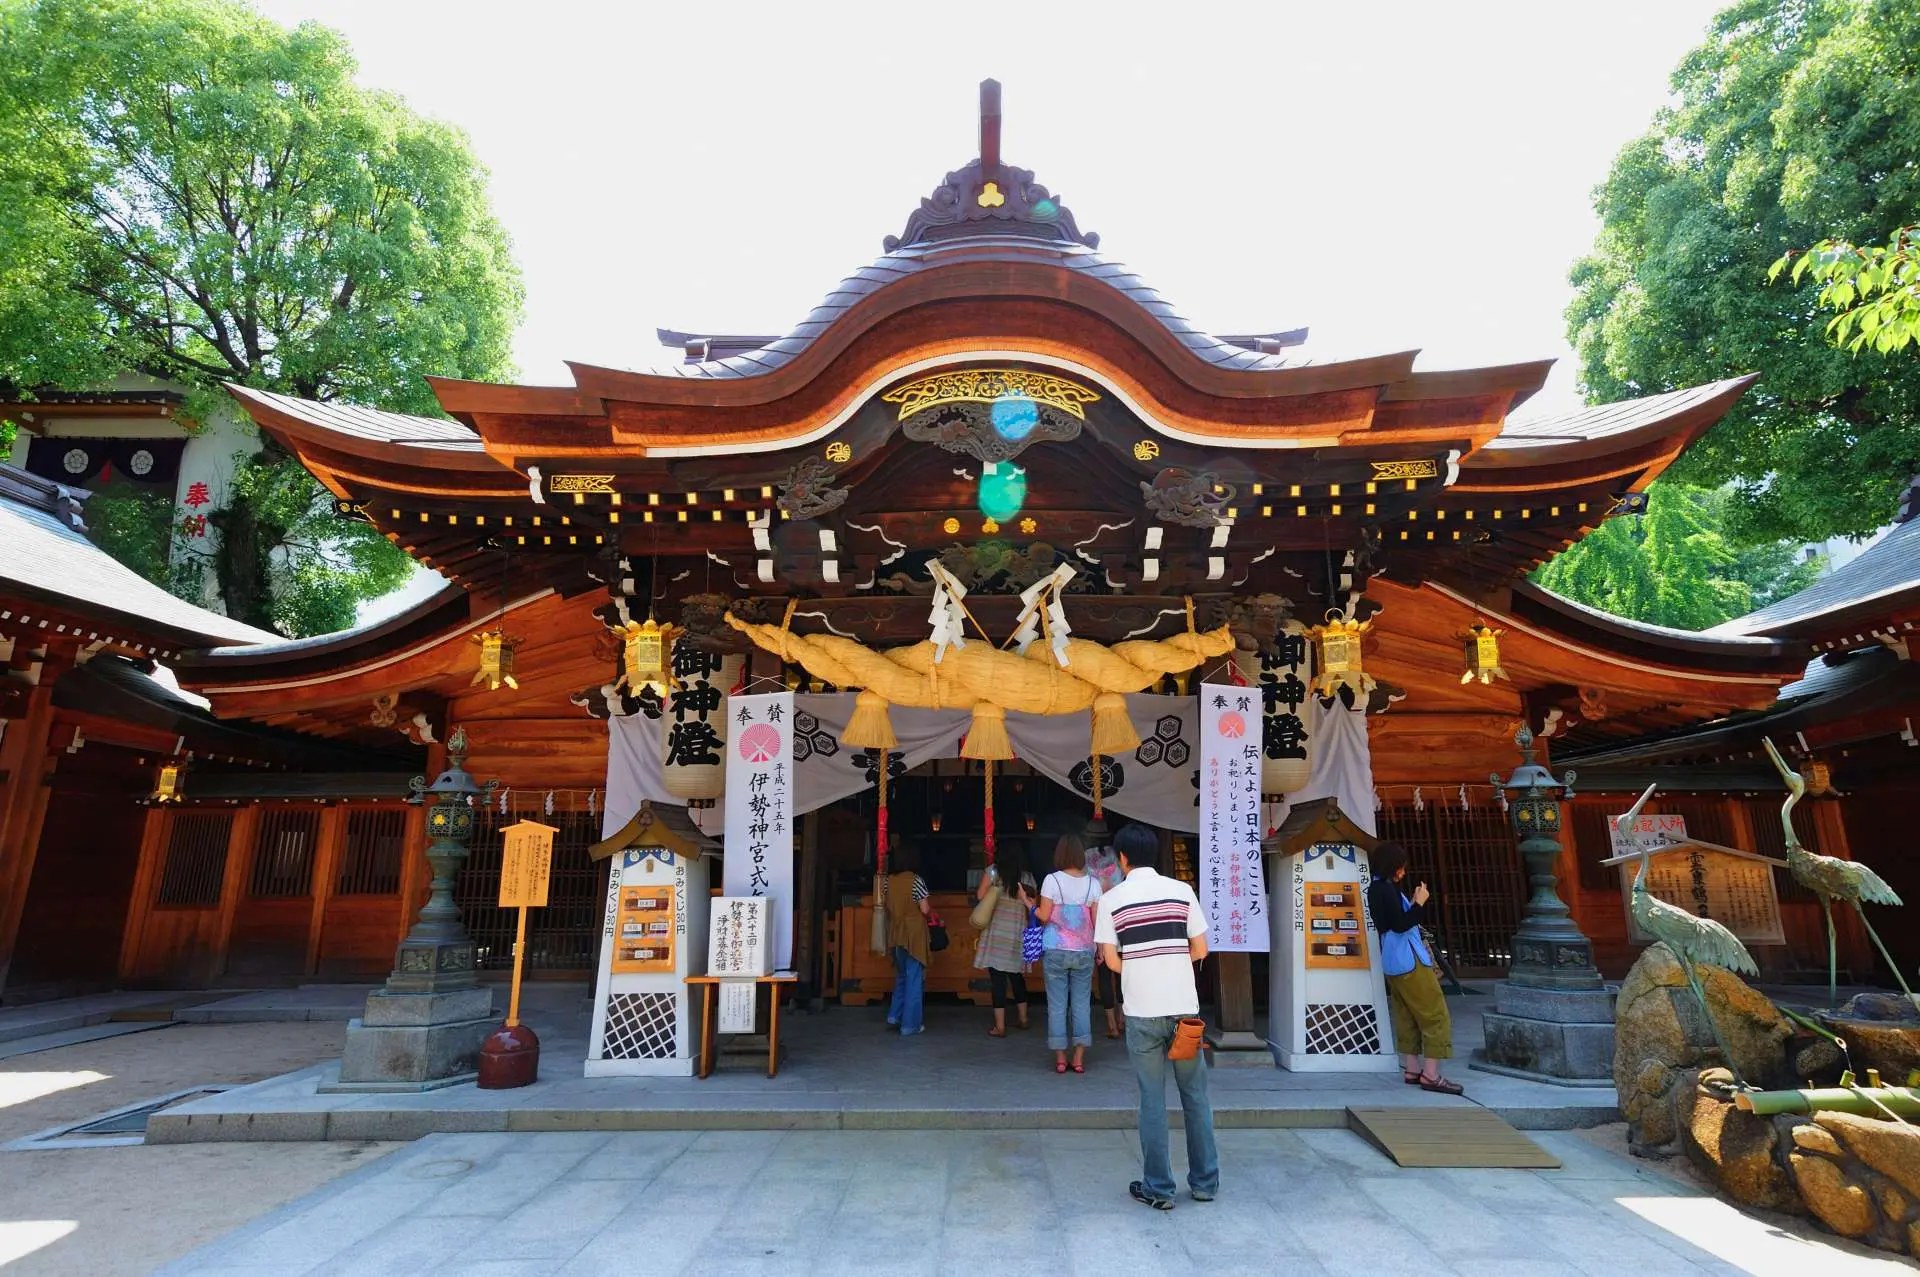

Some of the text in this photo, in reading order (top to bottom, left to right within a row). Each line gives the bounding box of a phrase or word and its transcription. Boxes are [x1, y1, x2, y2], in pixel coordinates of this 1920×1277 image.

[665, 636, 725, 766] 御神燈
[736, 702, 784, 726] 奉賛
[1212, 694, 1251, 712] 奉賛
[773, 762, 785, 835] 平成二十五年
[1227, 758, 1240, 846] お祀りしましょう
[1243, 744, 1261, 916] 伝えよう日本のこころ
[1209, 757, 1221, 945] ありがとうと言える心を育てましょう
[604, 868, 621, 937] おみくじ30円
[675, 866, 686, 935] おみくじ30円
[1294, 863, 1304, 932] おみくじ30円
[1358, 863, 1376, 931] おみくじ3円
